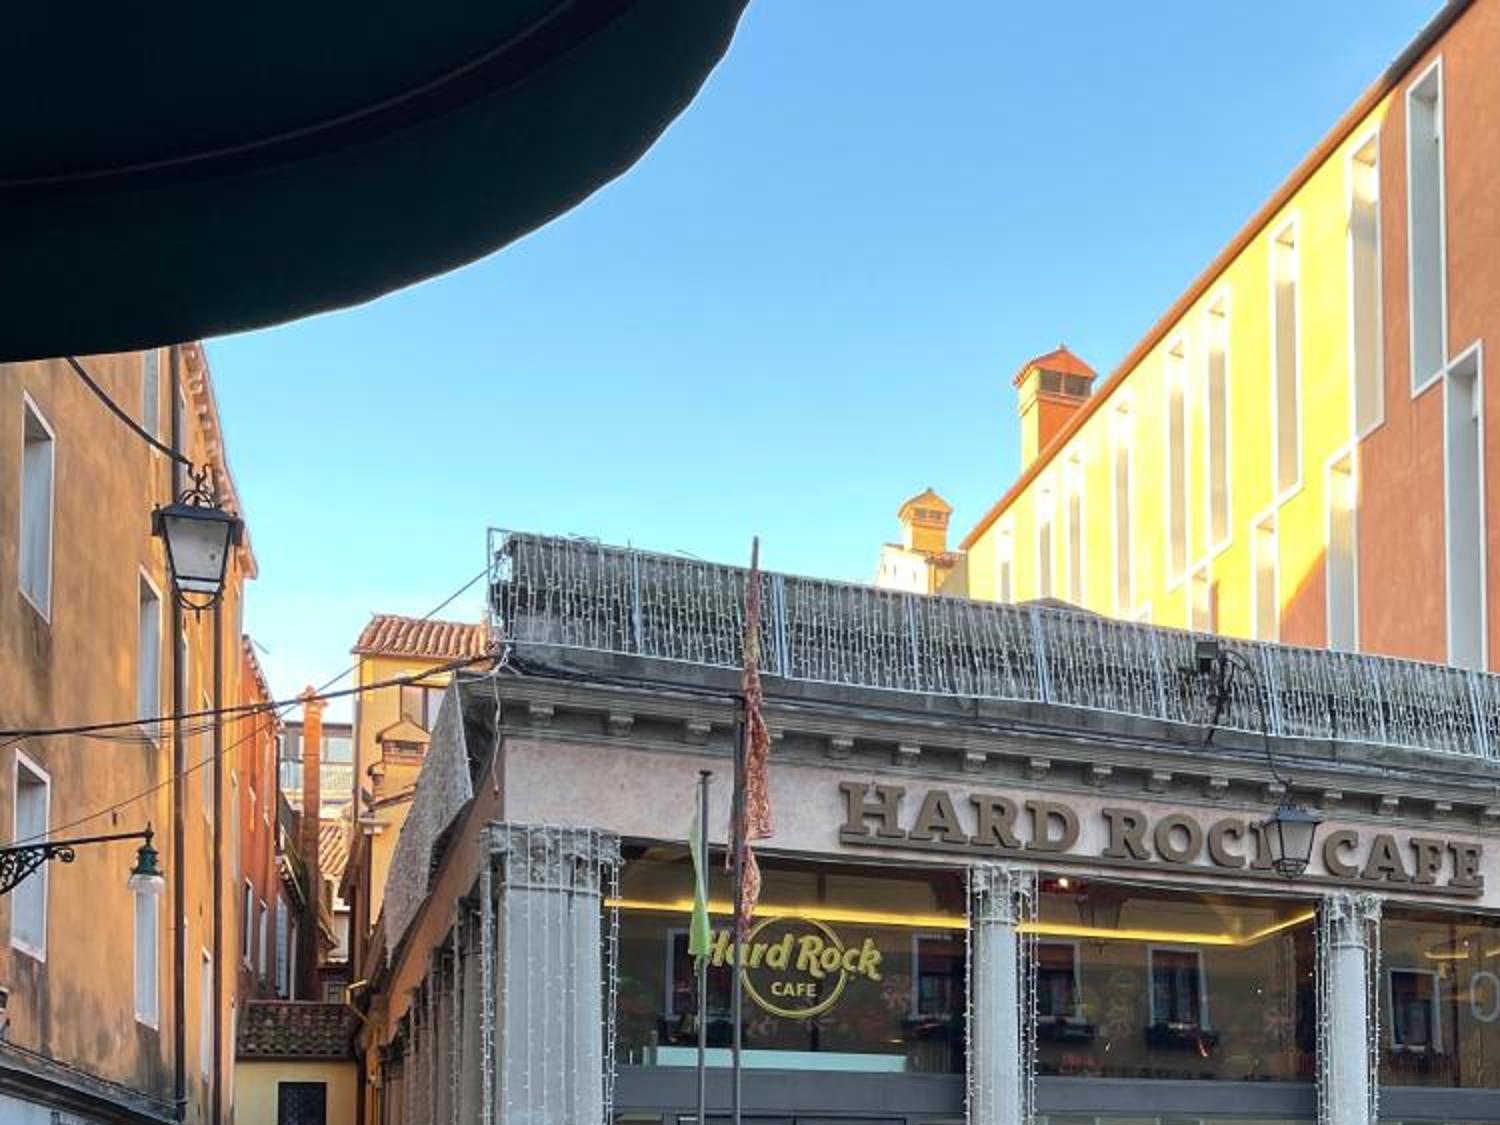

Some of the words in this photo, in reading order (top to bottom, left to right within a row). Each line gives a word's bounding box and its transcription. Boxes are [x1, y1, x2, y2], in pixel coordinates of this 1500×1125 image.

[839, 781, 1080, 852] HARD
[1323, 830, 1483, 888] CAFE
[796, 934, 882, 981] Rock
[770, 981, 817, 998] CAFE
